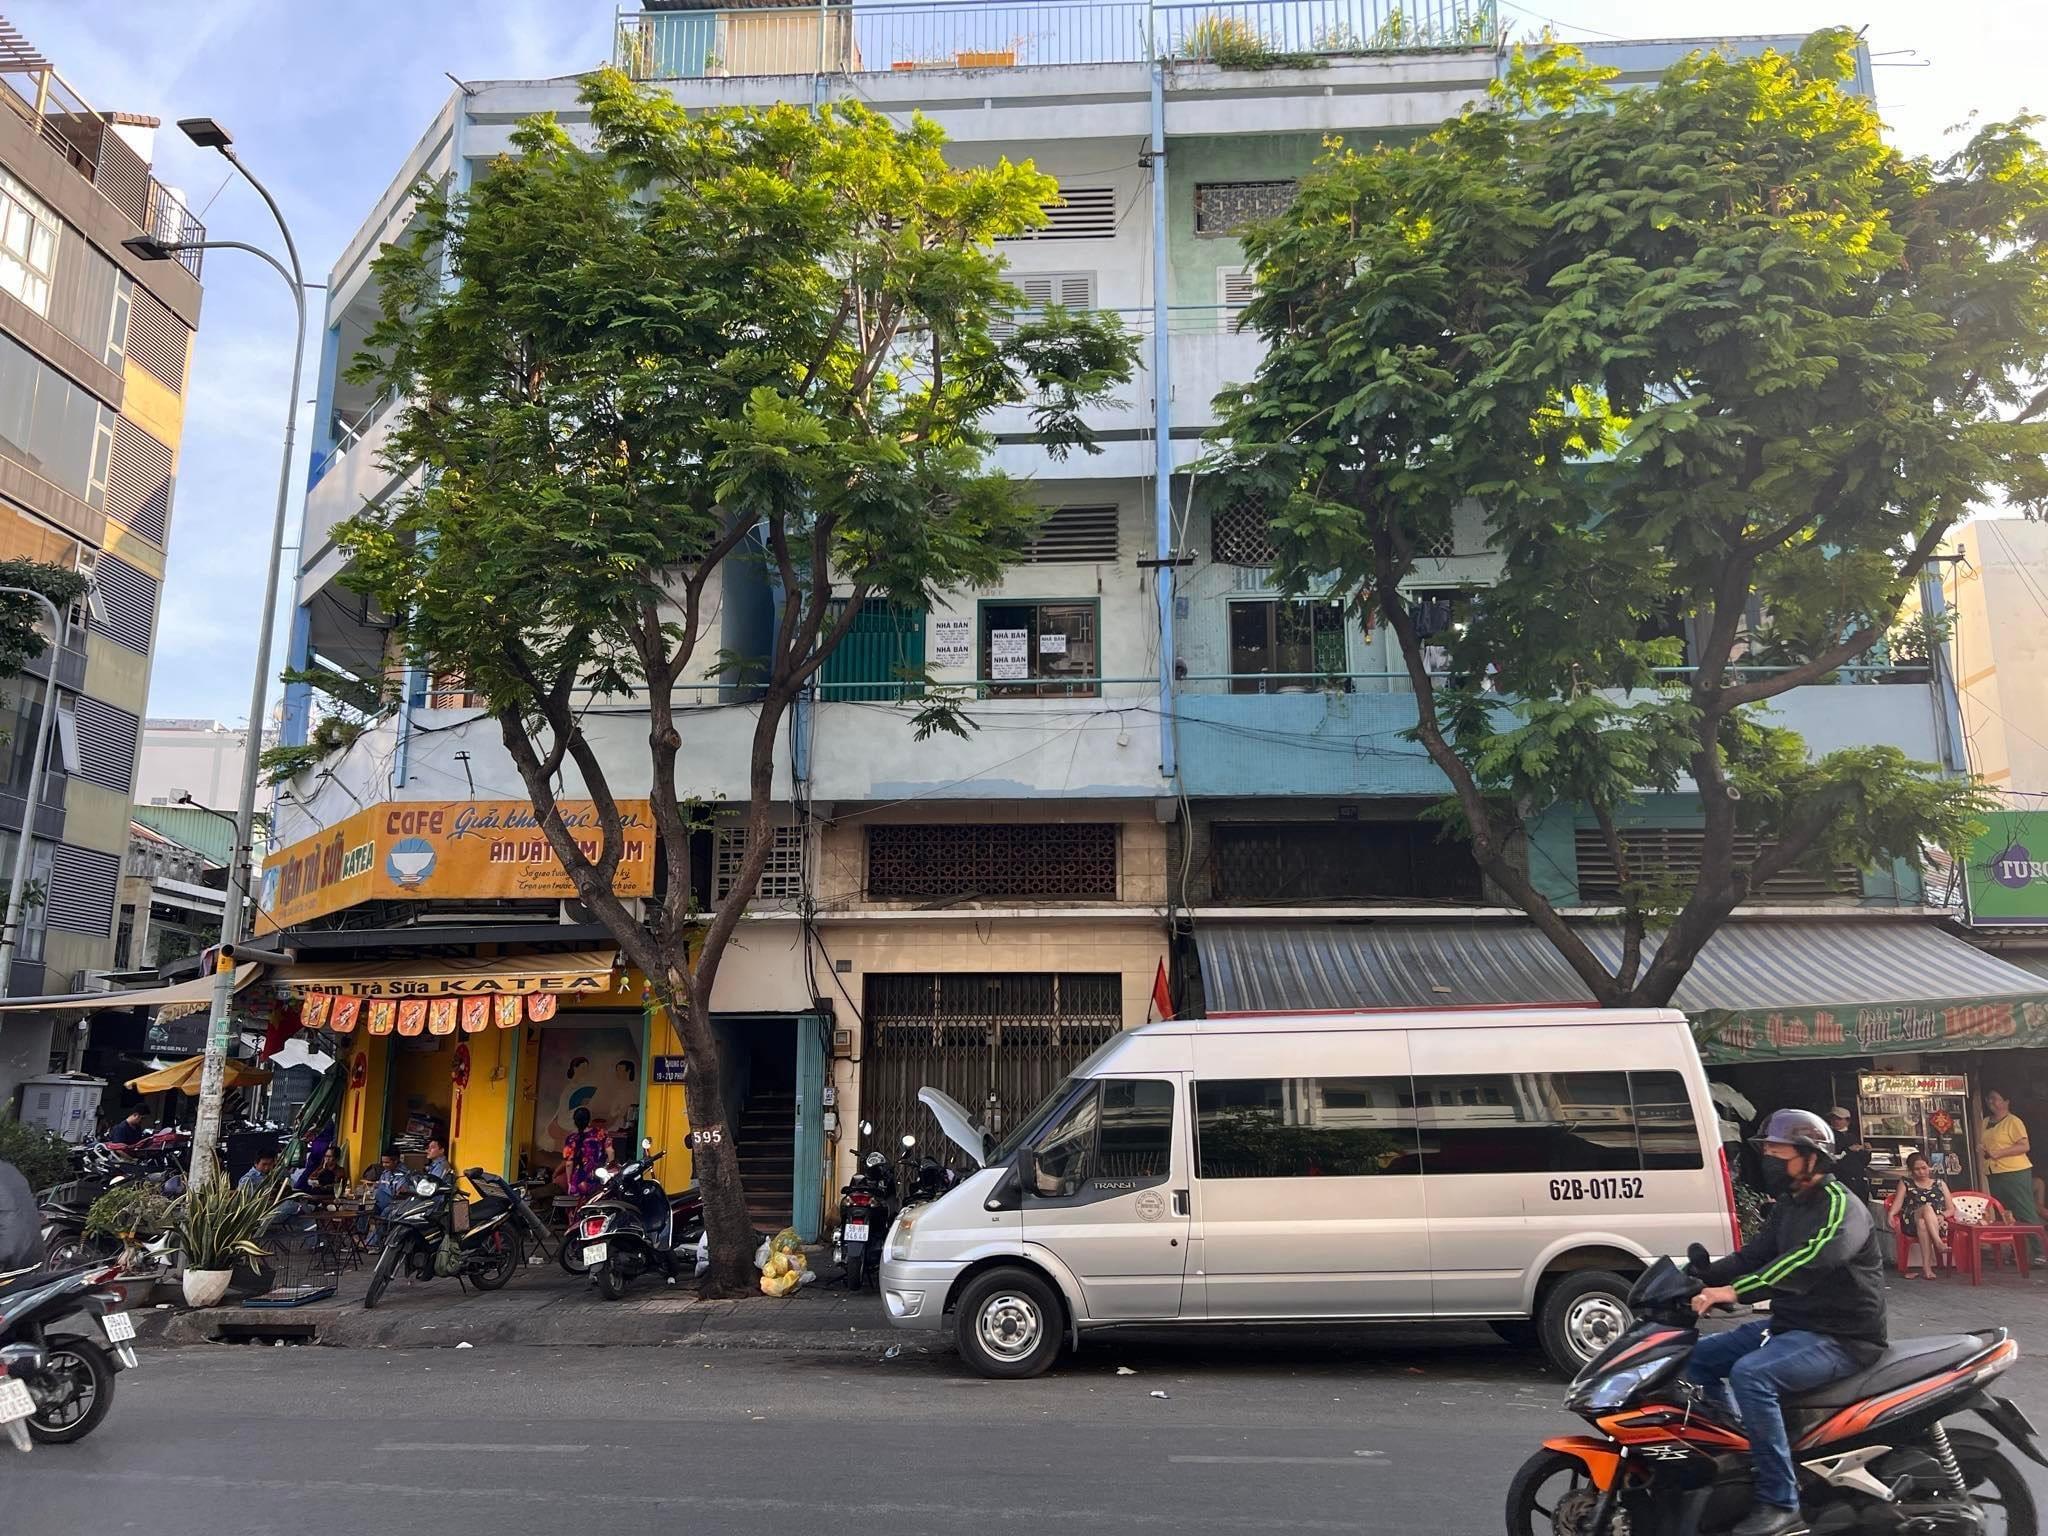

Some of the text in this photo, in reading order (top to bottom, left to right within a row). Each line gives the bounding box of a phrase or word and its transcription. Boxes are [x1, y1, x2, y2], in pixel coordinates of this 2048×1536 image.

[342, 841, 375, 880] KATEA
[440, 976, 600, 991] KATEA
[693, 1130, 722, 1143] 595
[1549, 1177, 1644, 1201] 62B-017.52
